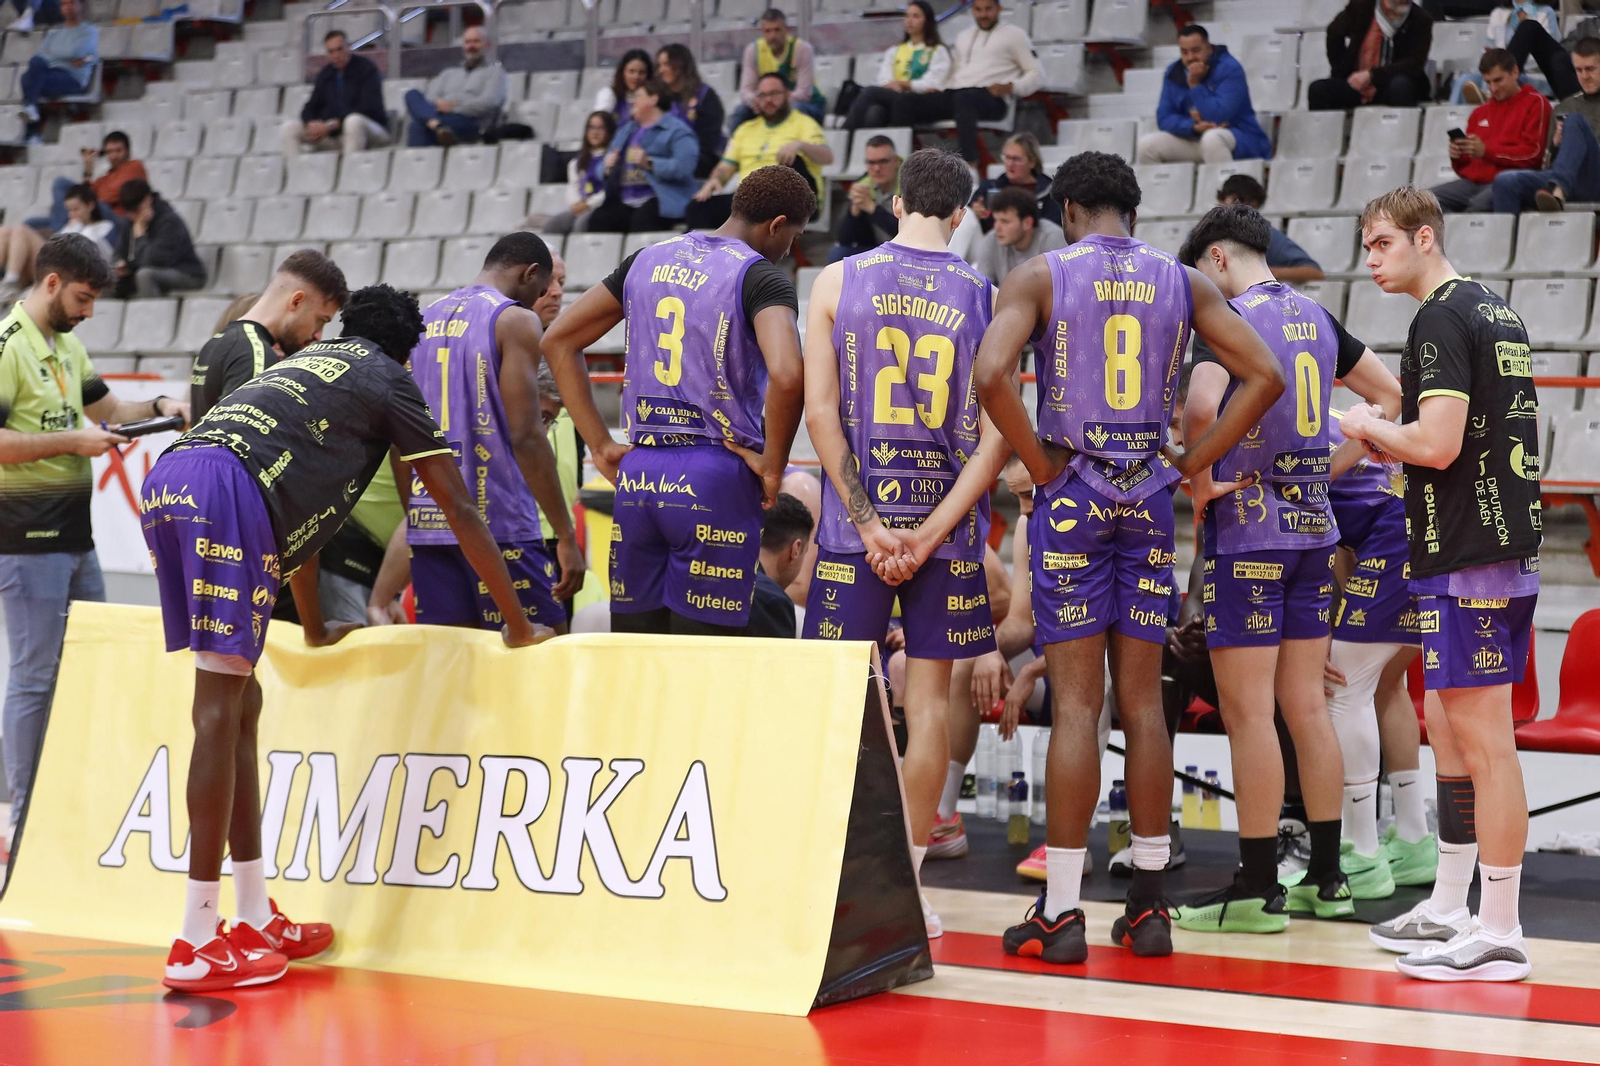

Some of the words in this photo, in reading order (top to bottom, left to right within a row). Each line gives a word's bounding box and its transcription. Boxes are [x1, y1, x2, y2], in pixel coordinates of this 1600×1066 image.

[651, 262, 709, 292] ROÉSLEY
[1093, 280, 1156, 305] BAMADU
[871, 293, 966, 332] SIGISMONTI
[653, 296, 686, 387] 3
[1054, 320, 1068, 379] RUSTER
[844, 331, 858, 392] RUSTER
[1103, 314, 1142, 411] 8
[436, 347, 451, 432] 1
[873, 326, 956, 430] 23
[1294, 351, 1322, 438] 0
[654, 406, 677, 416] CAJA
[1111, 432, 1133, 442] CAJA
[1134, 431, 1160, 441] RURAL
[1127, 441, 1149, 450] JAEN
[901, 449, 924, 459] CAJA
[916, 460, 941, 470] JAEN
[257, 449, 294, 489] Blanca
[618, 472, 698, 498] Andalucía
[911, 478, 944, 494] ORO
[1475, 480, 1486, 497] DE
[1424, 482, 1437, 542] Blanca
[1478, 499, 1492, 526] JAÉN
[1486, 477, 1510, 546] DIPUTACIÓN
[695, 524, 746, 543] Blaveo
[195, 537, 244, 560] Blaveo
[689, 560, 744, 580] Blanca
[192, 578, 240, 602] Blanca
[478, 578, 531, 595] Bca
[686, 589, 743, 612] intelec
[947, 625, 992, 646] intelec
[99, 744, 729, 903] AIMERKA
